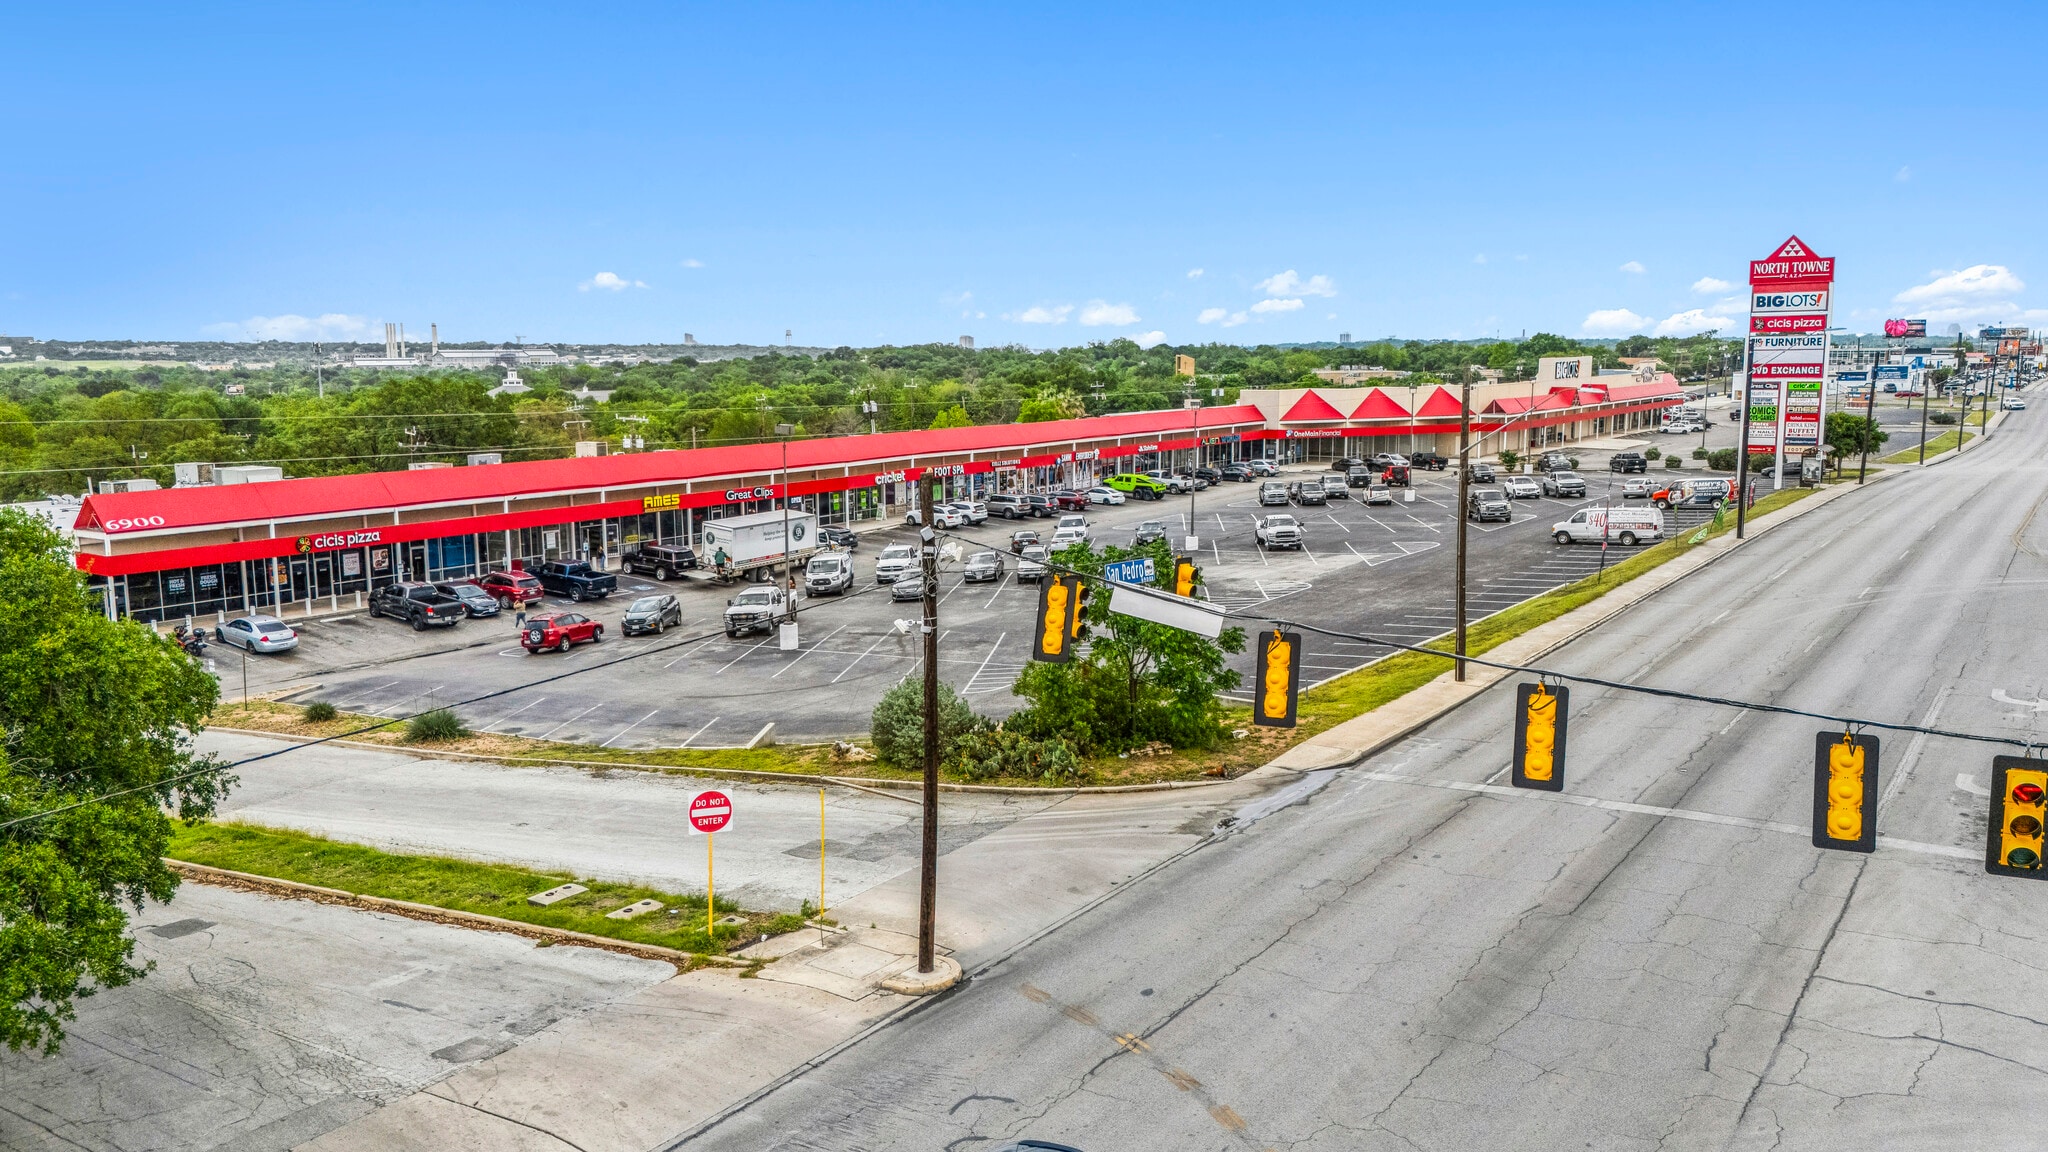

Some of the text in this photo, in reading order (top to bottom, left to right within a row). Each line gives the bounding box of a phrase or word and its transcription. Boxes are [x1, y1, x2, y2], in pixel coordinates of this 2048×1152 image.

[1753, 261, 1830, 274] NORTH TOWNE
[1756, 295, 1785, 308] BIG
[1767, 318, 1822, 329] cicis pizza
[1765, 338, 1823, 346] FURNITURE
[1771, 367, 1820, 375] EXCHANGE
[934, 464, 965, 477] FOOT SPA
[875, 470, 905, 485] cricket
[643, 493, 680, 508] AMES
[726, 487, 774, 501] Great Clips
[105, 515, 165, 530] 6900
[315, 531, 381, 548] cicis pizza
[1106, 561, 1144, 582] San Pedro
[698, 817, 723, 826] ENTER
